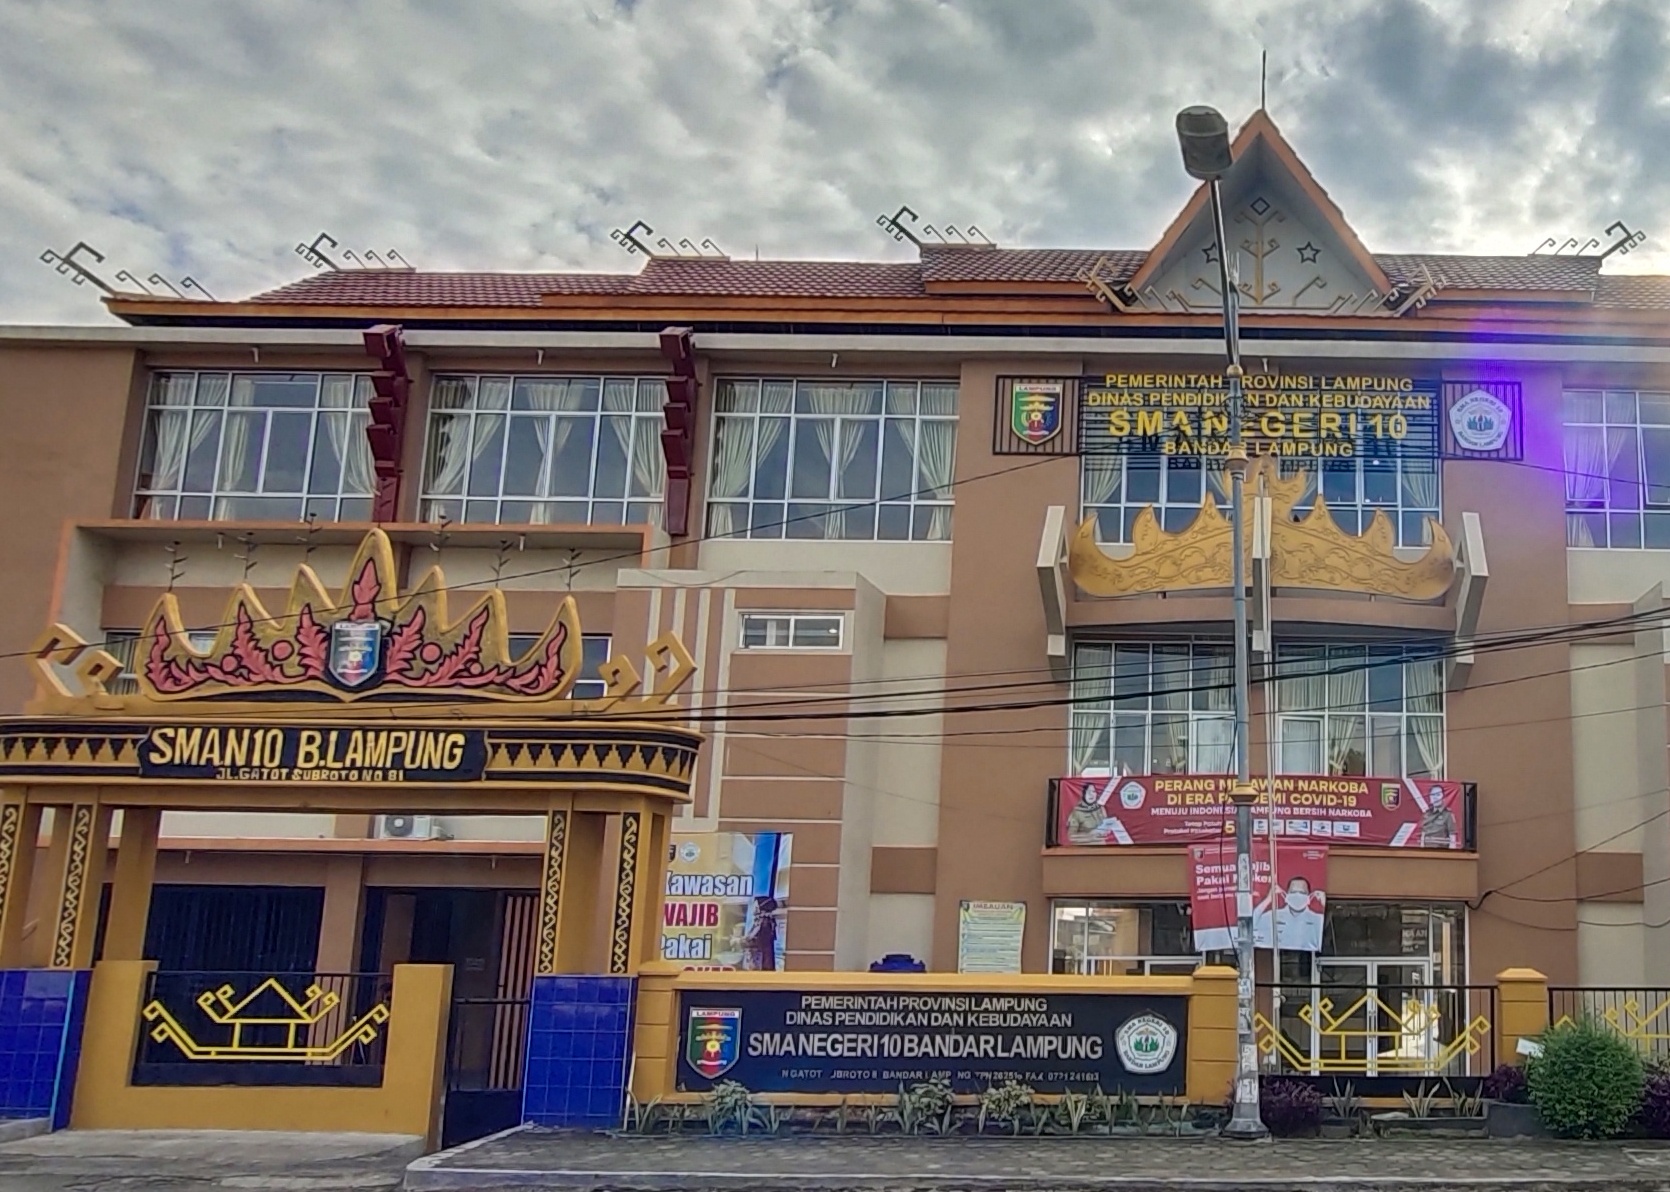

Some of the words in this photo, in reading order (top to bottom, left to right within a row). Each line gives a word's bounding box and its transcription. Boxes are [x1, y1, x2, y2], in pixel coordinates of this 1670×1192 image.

[1106, 374, 1222, 388] PEMERINTAH
[1242, 375, 1313, 390] ROVINSI
[1321, 376, 1413, 391] LAMPUNG
[1088, 392, 1144, 406] DINAS
[1149, 392, 1259, 407] PENDIDIKN
[1265, 393, 1304, 408] DAN
[1309, 394, 1430, 410] KEBUDAYAAN
[1370, 413, 1408, 440] 10
[1255, 441, 1353, 457] LAMPUNG
[296, 729, 466, 770] B.LAMPUNG
[291, 768, 358, 781] SUBROTO
[362, 769, 383, 781] NO
[388, 769, 404, 782] 81
[1154, 779, 1216, 792] PERANG
[1219, 778, 1294, 792] MEAWAN
[1301, 780, 1369, 794] NARKOBA
[1167, 793, 1182, 806] DI
[1186, 793, 1215, 805] ERA
[1219, 792, 1287, 805] PAEMI
[1290, 795, 1357, 807] COVID-19
[1151, 806, 1188, 816] MENUJU
[1250, 806, 1291, 815] AMPUNG
[1293, 807, 1327, 816] BERSIH
[1328, 808, 1373, 818] NARKOBA
[1224, 820, 1236, 834] 5
[1195, 863, 1237, 875] Semua
[1251, 861, 1271, 873] ajib
[1196, 874, 1230, 886] Pakai
[801, 995, 898, 1009] PEMERINTAH
[899, 996, 969, 1011] PROVINSI
[971, 997, 1048, 1012] LAMPUNG
[785, 1011, 833, 1025] DINAS
[834, 1011, 928, 1026] PENDIDIKAN
[930, 1012, 964, 1027] DAN
[967, 1013, 1073, 1028] KEBUDAYAAN
[747, 1032, 797, 1057] SMA
[798, 1033, 879, 1058] NEGERI
[880, 1033, 902, 1058] 10
[903, 1034, 995, 1059] BANDAR
[996, 1034, 1103, 1060] LAMPUNG
[789, 1069, 823, 1079] GATOT
